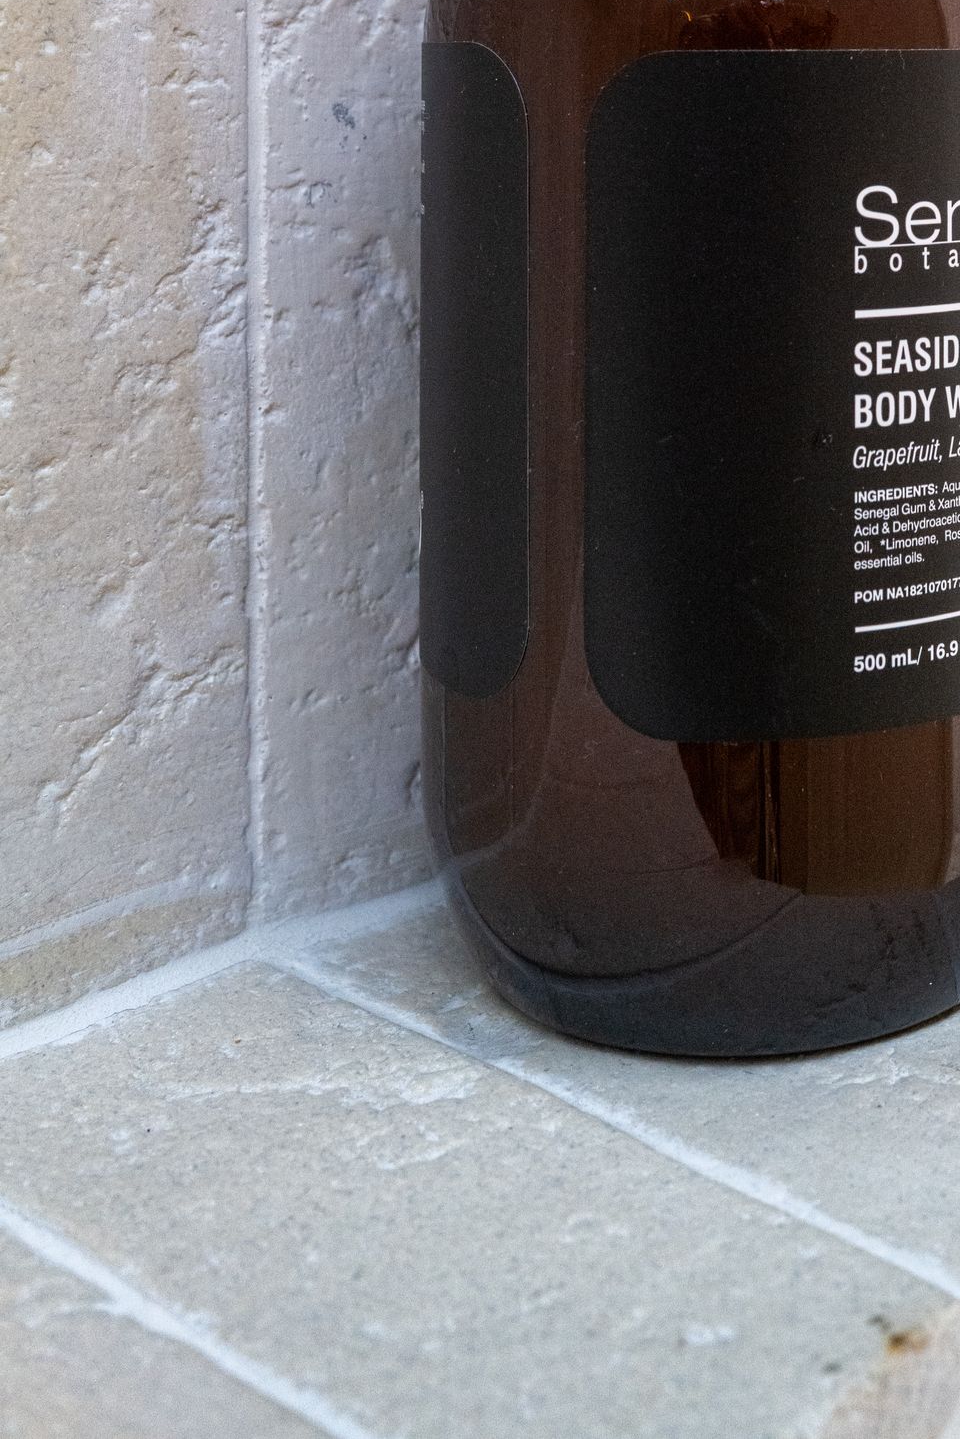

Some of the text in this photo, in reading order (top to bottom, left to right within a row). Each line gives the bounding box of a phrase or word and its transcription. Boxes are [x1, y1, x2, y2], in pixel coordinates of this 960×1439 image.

[854, 388, 936, 429] BODY
[853, 439, 942, 471] Grapefruit,
[854, 483, 938, 504] INGREDIENTS:
[854, 504, 899, 520] Senegal
[901, 503, 926, 515] Gum
[928, 499, 937, 511] &
[853, 523, 879, 537] Acid
[881, 522, 890, 534] &
[854, 540, 873, 554] Oil,
[854, 551, 925, 570] essential oils.
[854, 589, 883, 603] POM
[853, 653, 886, 673] 500
[891, 646, 923, 667] mL/
[927, 640, 959, 661] 16.9
